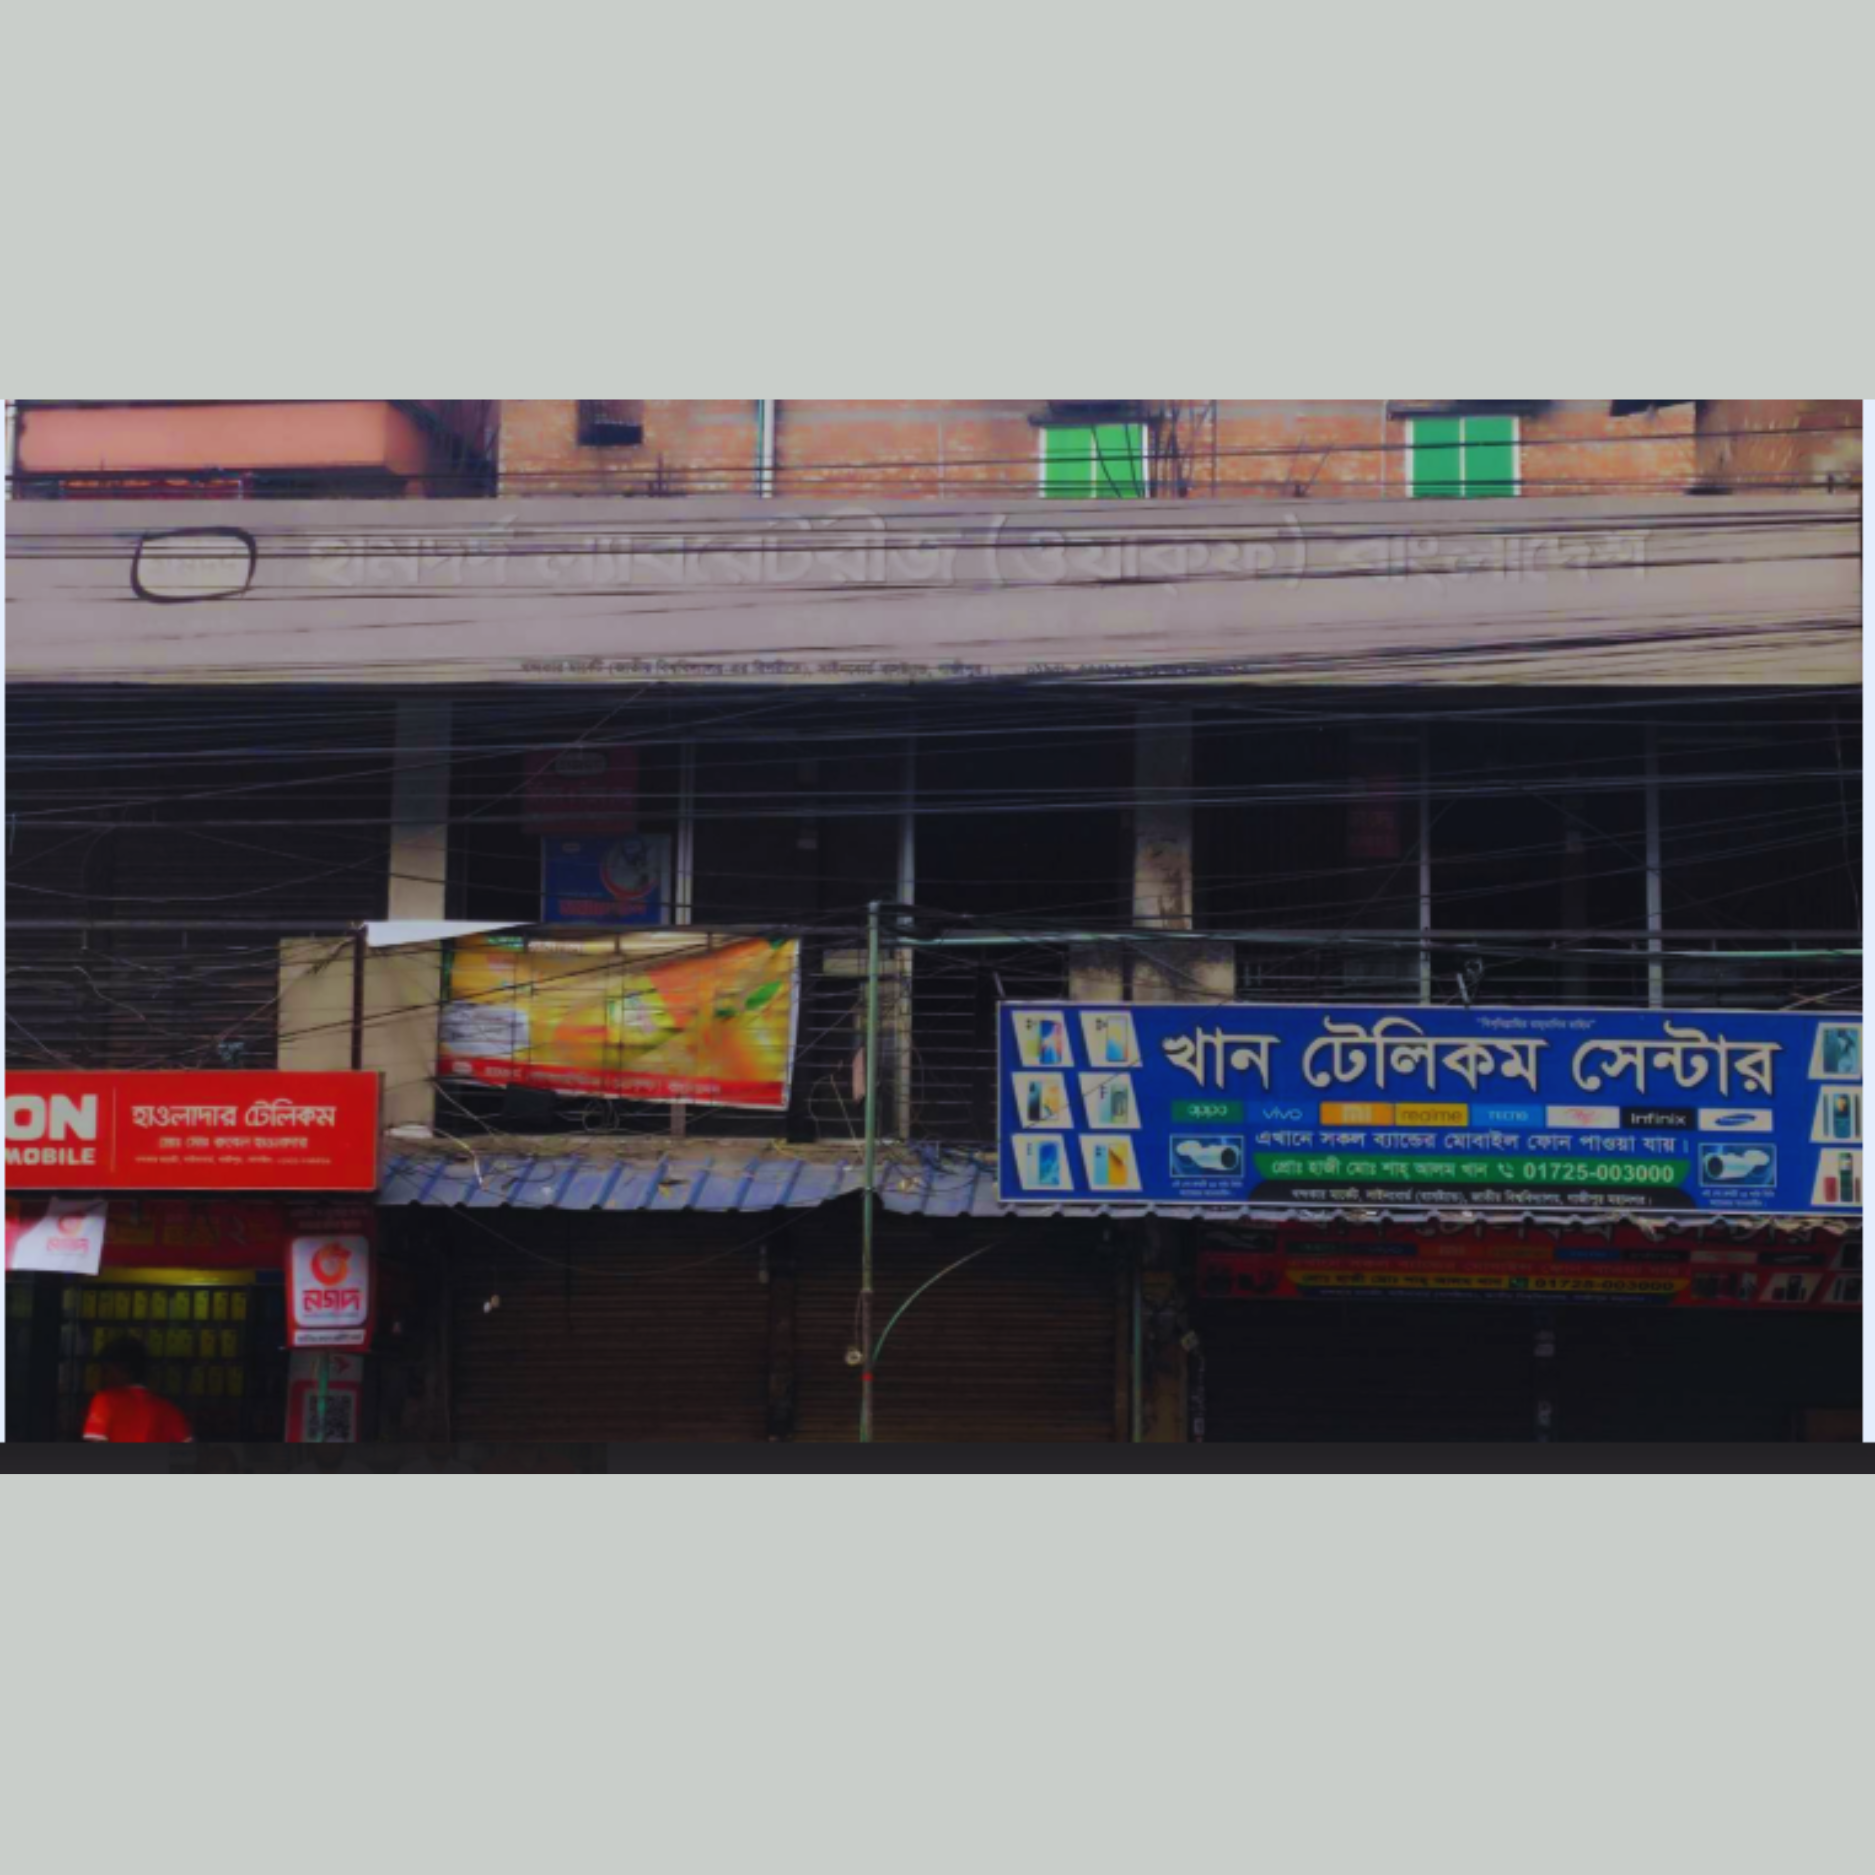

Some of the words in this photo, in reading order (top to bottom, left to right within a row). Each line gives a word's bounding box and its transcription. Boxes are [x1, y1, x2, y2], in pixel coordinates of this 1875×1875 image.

[1334, 530, 1651, 597] বাংলাদেশ
[1161, 1026, 1281, 1091] খান
[1301, 1015, 1549, 1093] টেলিকম
[1572, 1019, 1783, 1098] সেন্টার
[131, 1104, 238, 1129] হাওলাদার
[244, 1098, 337, 1129] টেলিকম
[1187, 1104, 1228, 1118] oppo
[1262, 1105, 1304, 1121] vivo
[1401, 1105, 1463, 1123] realme
[1488, 1109, 1530, 1122] TECNO
[1630, 1111, 1687, 1126] Infinix
[1255, 1129, 1314, 1147] এখানে
[1319, 1130, 1367, 1148] সকল
[1443, 1128, 1521, 1151] মোবাইল
[1526, 1133, 1573, 1151] ফোন
[1579, 1134, 1636, 1152] পাওয়া
[1307, 1154, 1341, 1176] হাজী
[1346, 1159, 1377, 1176] মোঃ
[1414, 1160, 1456, 1177] আলম
[1461, 1162, 1488, 1177] খান
[1522, 1161, 1675, 1183] 01725-003000
[302, 1288, 361, 1312] নগদ
